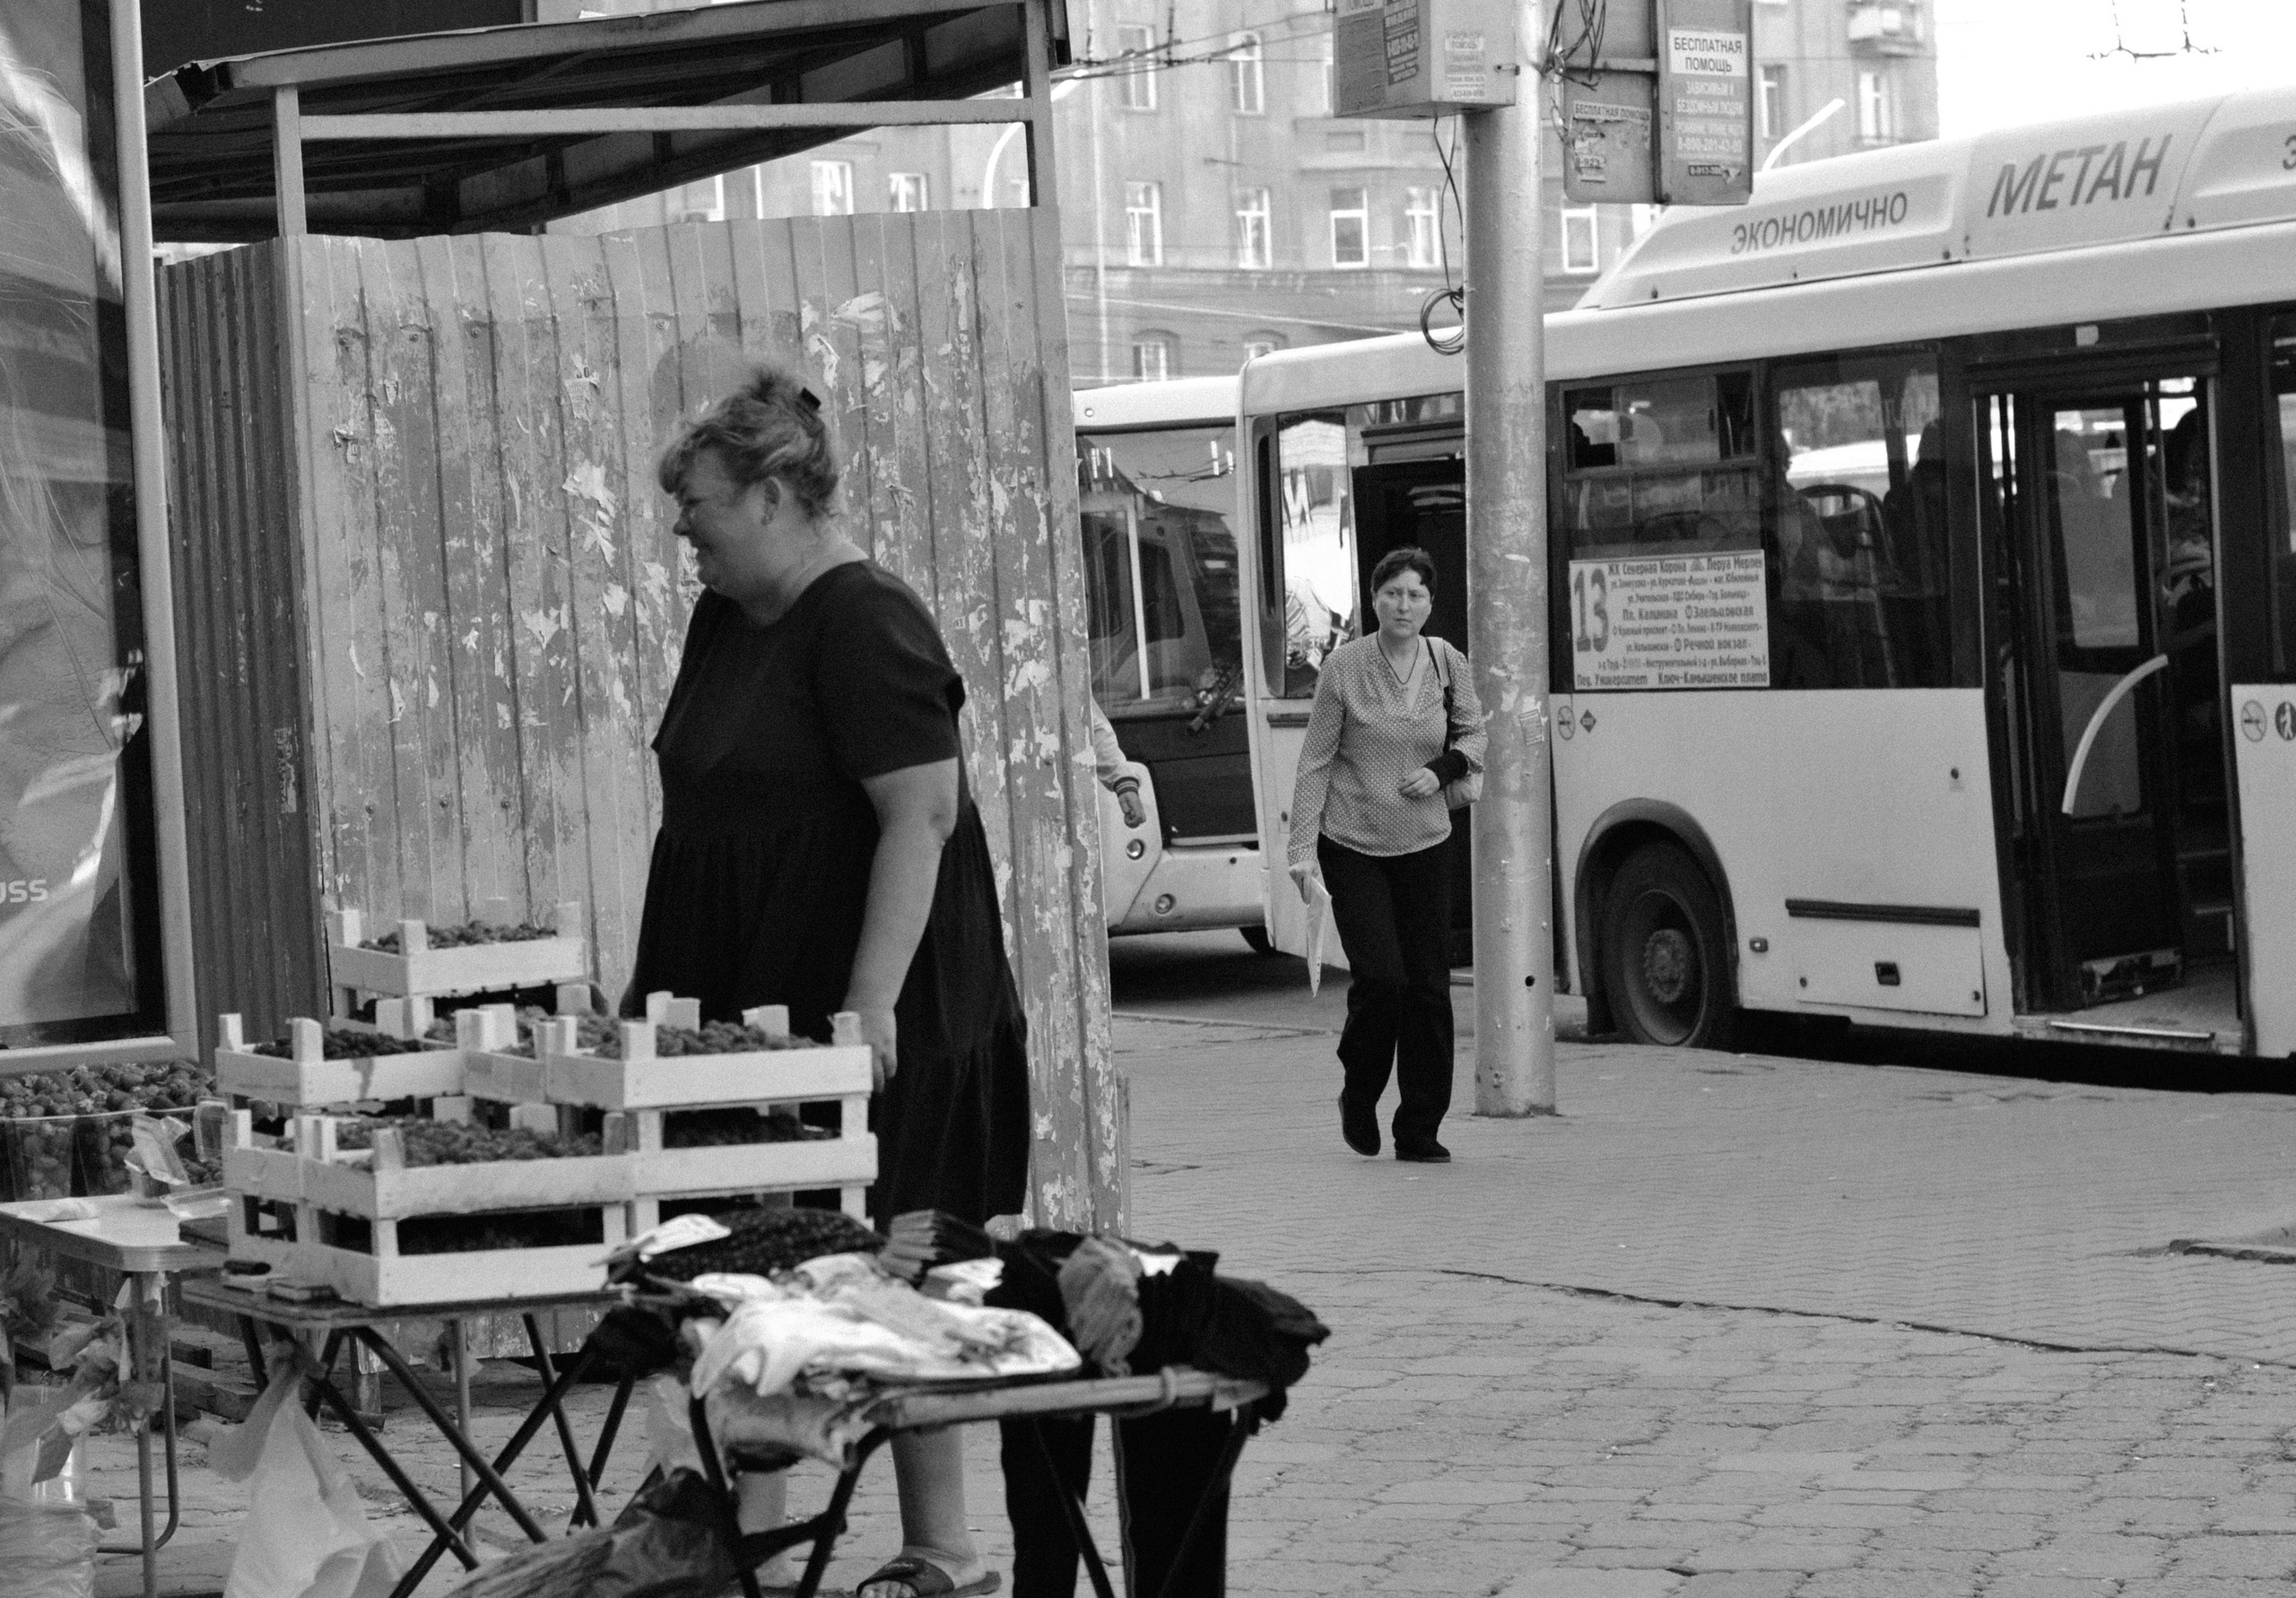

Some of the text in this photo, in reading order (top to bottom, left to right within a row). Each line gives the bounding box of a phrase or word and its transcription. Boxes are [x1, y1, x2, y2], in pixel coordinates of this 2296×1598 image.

[1674, 37, 1743, 54] БЕСПЛАТНАЯ
[1685, 56, 1733, 74] ПОМОЩЬ
[1576, 103, 1619, 118] БЕСПЛАТНАЯ
[1987, 133, 2173, 218] МЕТАН
[1731, 192, 1909, 255] ЭКОНОМИЧНО
[1622, 561, 1657, 575] Северная
[1660, 560, 1687, 573] Корона
[1574, 568, 1609, 652] 13
[1639, 608, 1678, 621] Калинина
[1693, 605, 1754, 619] Заельцовская
[1683, 638, 1715, 651] Речной
[1718, 638, 1748, 649] вокзал
